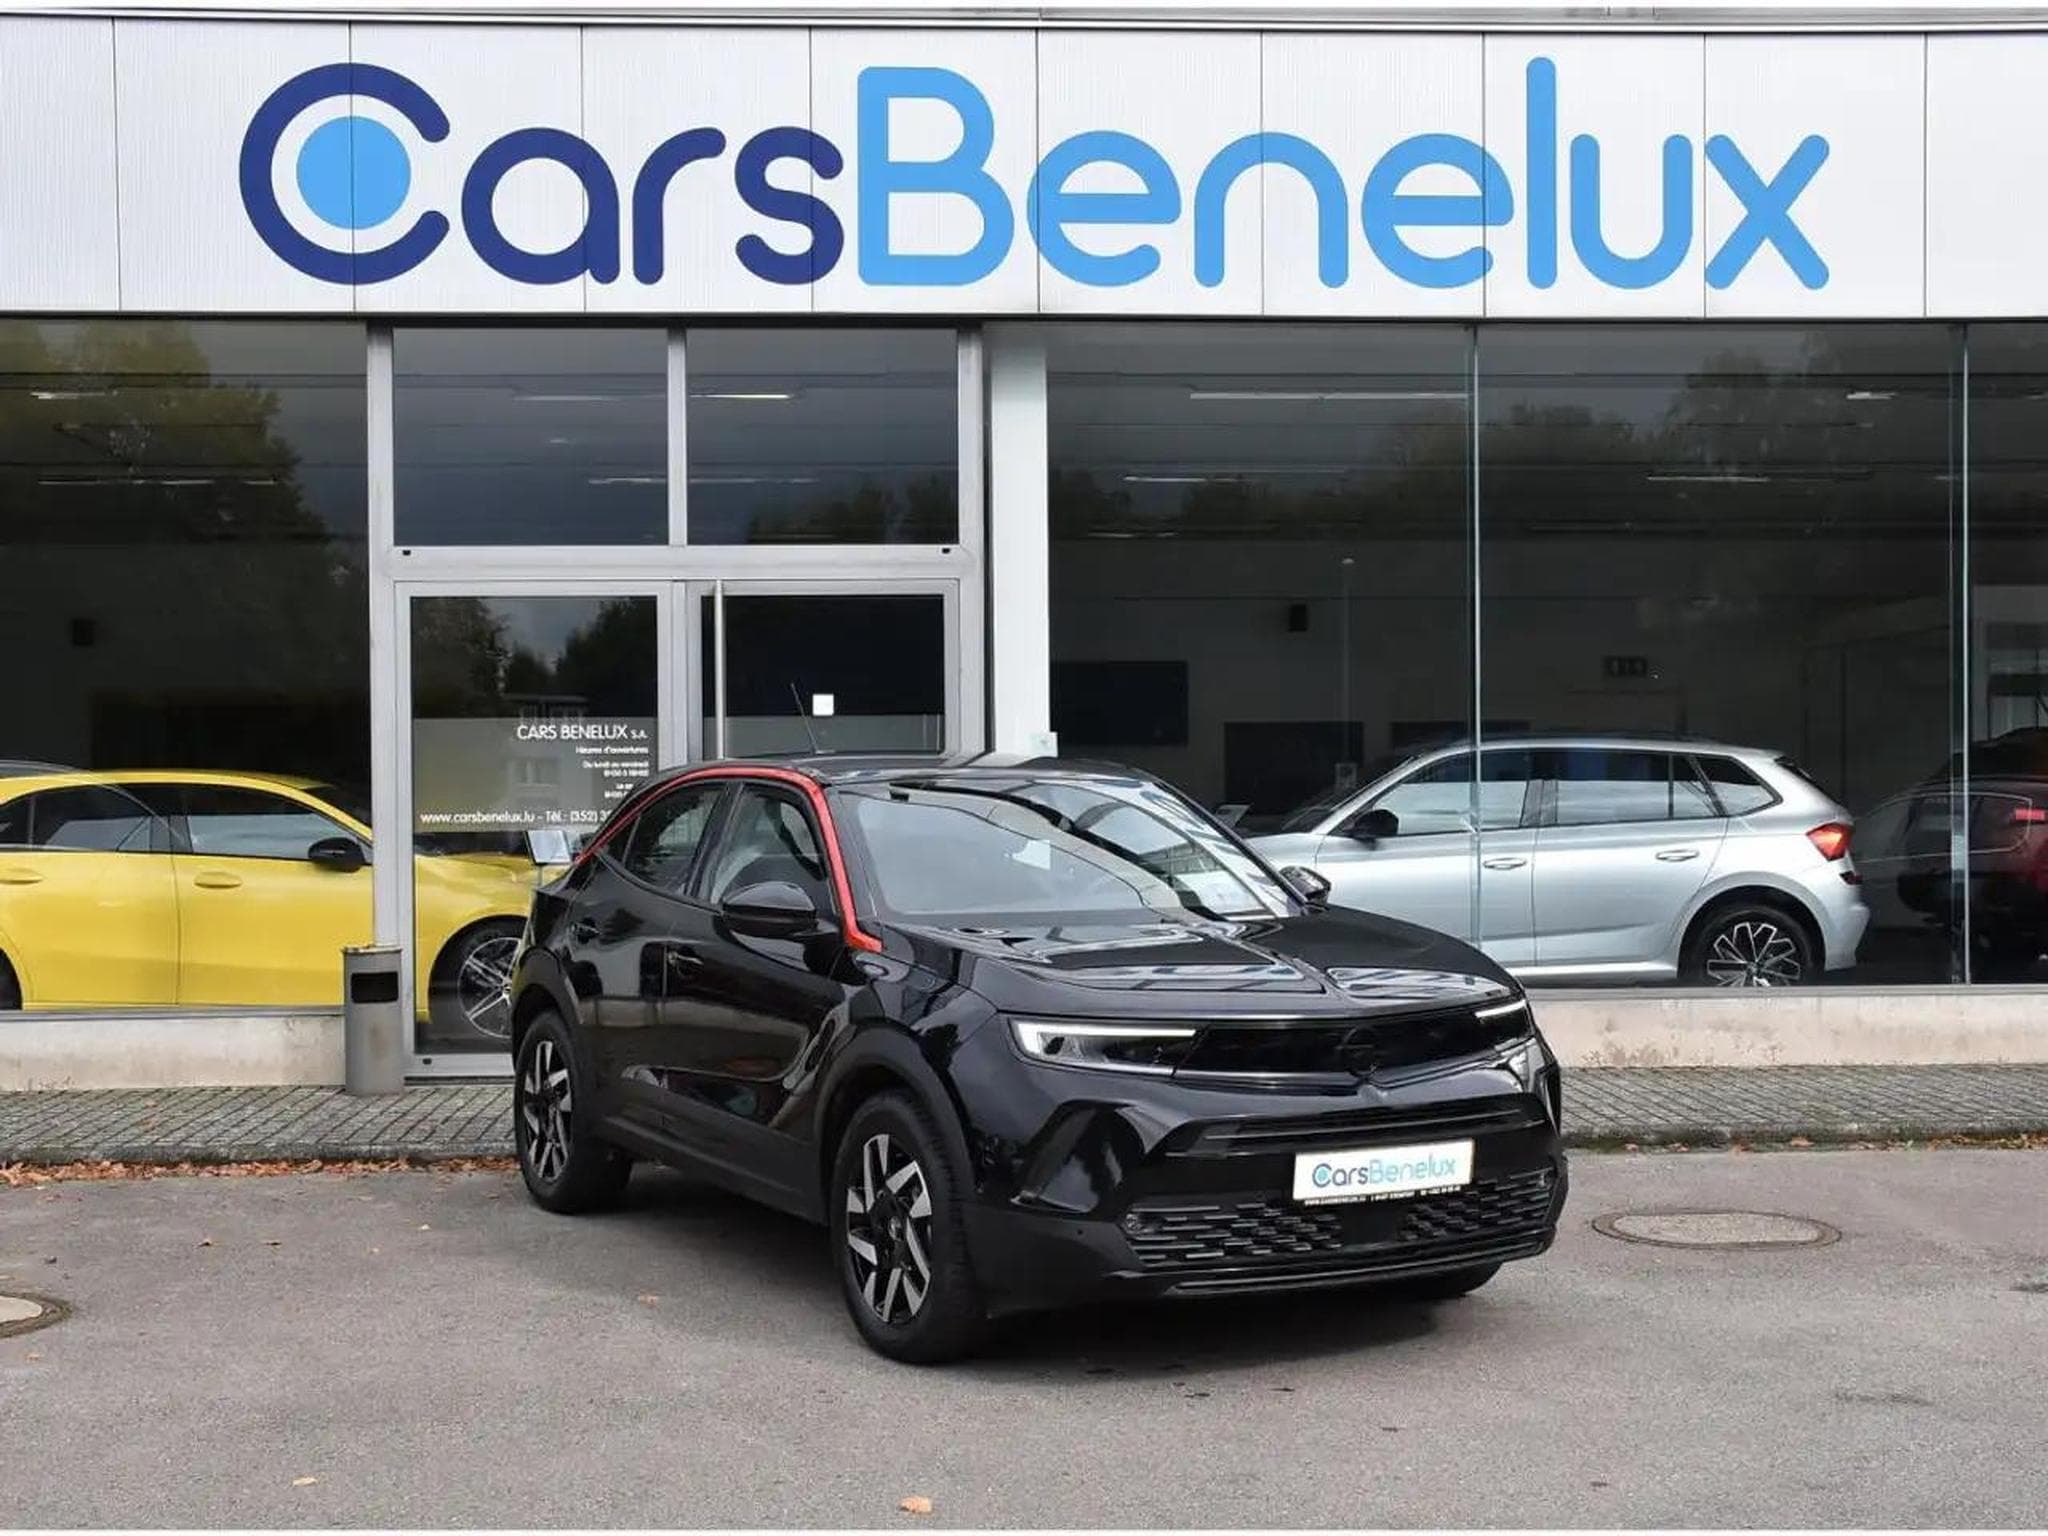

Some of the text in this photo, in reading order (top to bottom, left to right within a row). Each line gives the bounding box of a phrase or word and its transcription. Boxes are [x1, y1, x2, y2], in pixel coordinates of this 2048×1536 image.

[239, 57, 1831, 290] CarsBenelux
[517, 724, 558, 740] CARS
[560, 724, 628, 740] BENELUX
[420, 811, 535, 824] www.carsbenelux.lu
[1312, 1153, 1456, 1188] CarsBenelux
